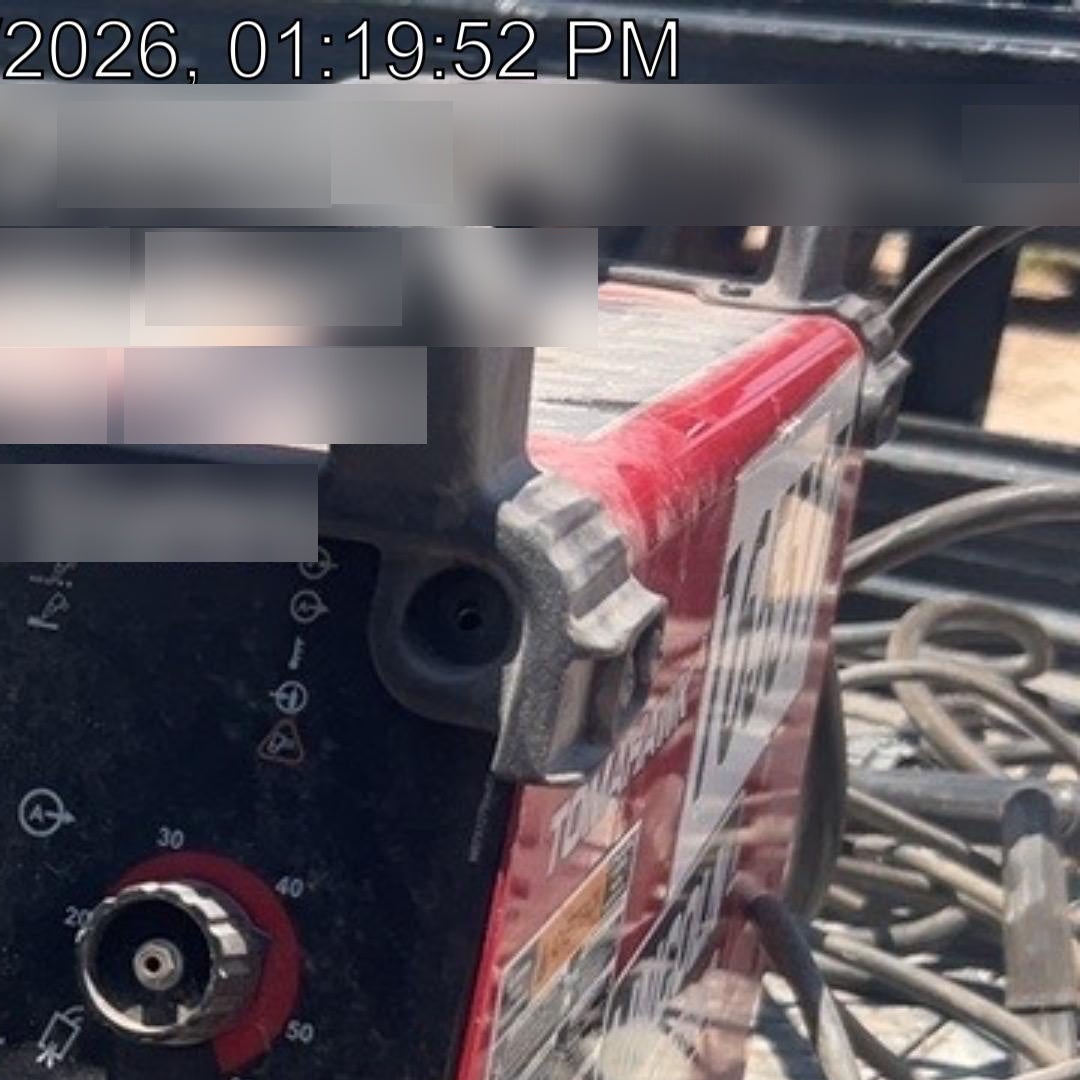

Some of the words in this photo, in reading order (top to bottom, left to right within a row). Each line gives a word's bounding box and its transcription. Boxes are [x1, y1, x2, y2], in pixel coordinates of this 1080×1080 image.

[155, 826, 185, 850] 30
[274, 874, 305, 899] 40
[63, 904, 94, 928] 20
[287, 1020, 315, 1044] 50
